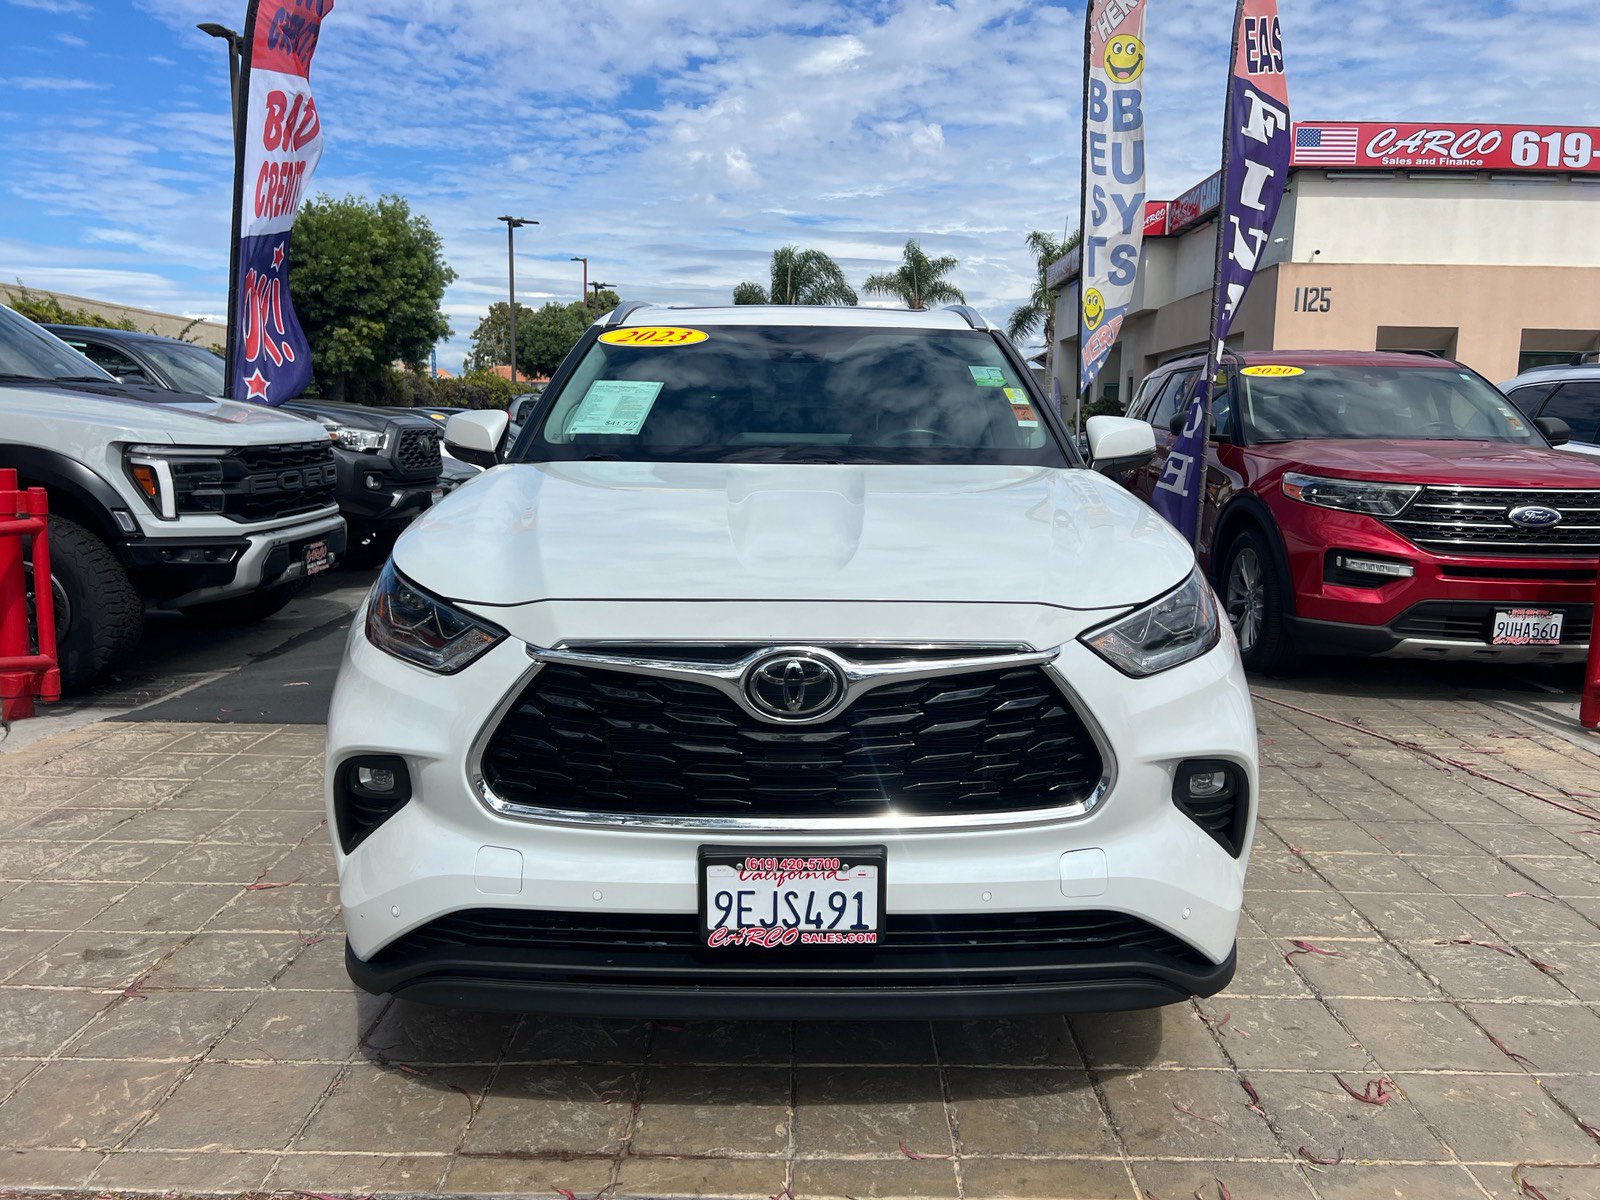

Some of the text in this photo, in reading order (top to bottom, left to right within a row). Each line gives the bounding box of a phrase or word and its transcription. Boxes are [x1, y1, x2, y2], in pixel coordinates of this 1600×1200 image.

[263, 90, 320, 152] BAD
[1365, 128, 1502, 159] CARCO
[1381, 156, 1483, 167] Sales and Finance
[254, 160, 306, 220] CREDIT
[1107, 89, 1146, 287] BUYS
[1294, 287, 1332, 312] 1125
[242, 267, 295, 368] OK!
[615, 330, 693, 343] 2023
[1251, 367, 1293, 375] 2020
[1496, 622, 1558, 638] 9UHA560
[744, 857, 840, 871] (619) 420-5700
[739, 870, 850, 888] California
[714, 890, 870, 930] 9EJS491
[708, 926, 877, 948] CARCO SALES.COM
